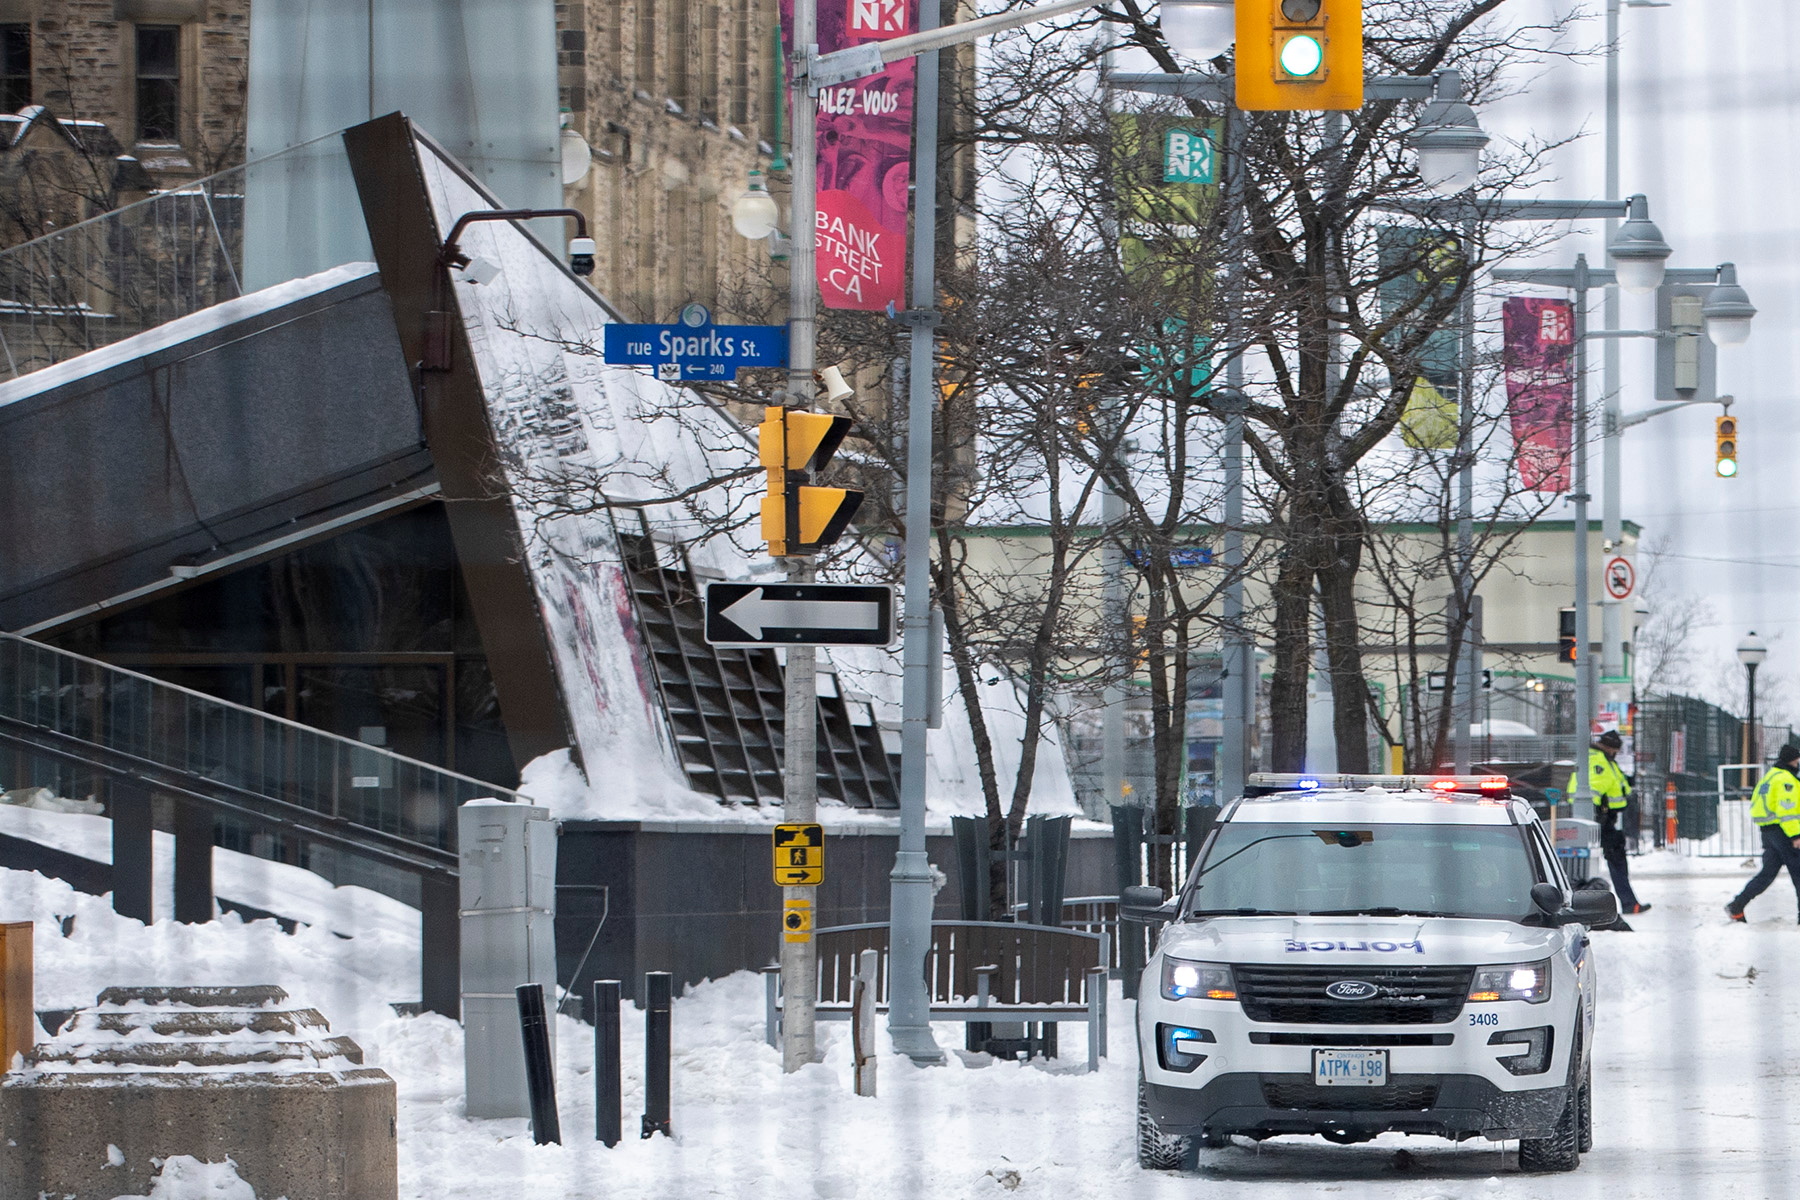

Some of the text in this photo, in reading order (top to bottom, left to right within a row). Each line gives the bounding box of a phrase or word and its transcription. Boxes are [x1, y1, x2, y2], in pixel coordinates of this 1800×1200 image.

[816, 87, 899, 115] ALEZ-VOUS
[815, 211, 880, 262] BANK
[815, 232, 883, 284] STREET
[823, 268, 862, 302] .CA
[627, 329, 760, 363] rue Sparks St.
[710, 364, 725, 375] 240
[1337, 982, 1366, 995] Ford
[1469, 1013, 1499, 1026] 3408
